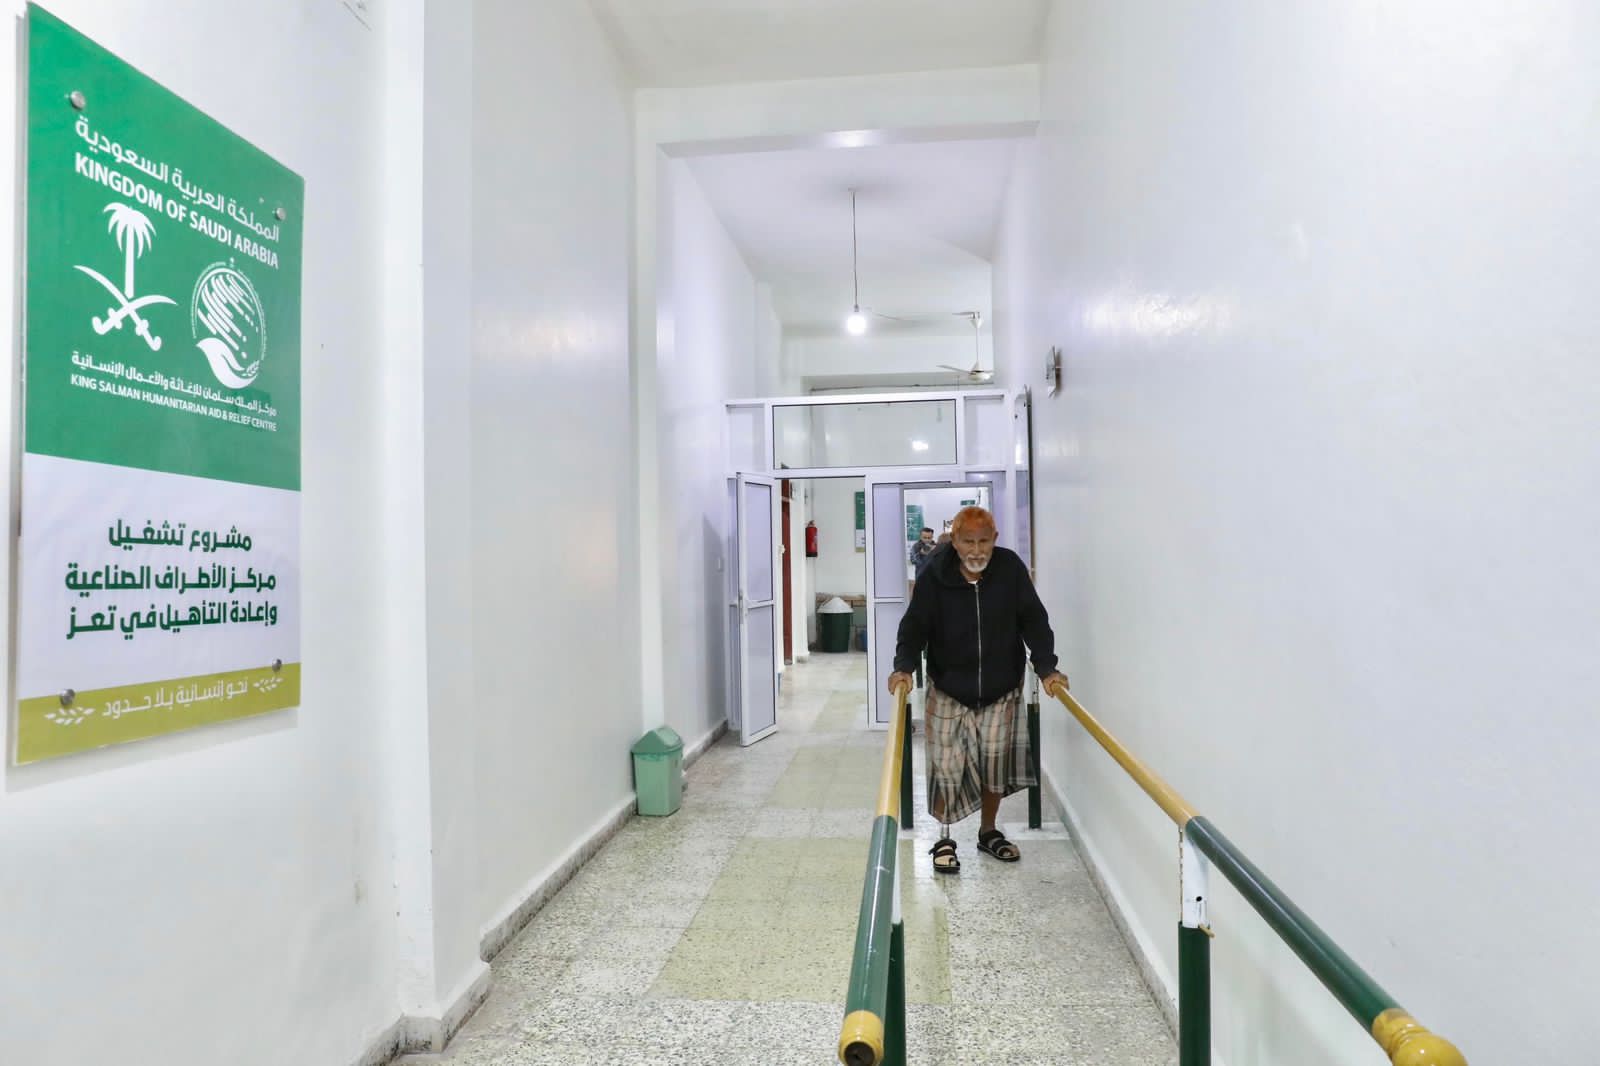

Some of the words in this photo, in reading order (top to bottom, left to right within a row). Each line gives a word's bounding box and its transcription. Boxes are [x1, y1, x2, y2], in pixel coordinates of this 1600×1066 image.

[75, 116, 168, 183] السعودية
[172, 168, 224, 210] العربية
[75, 152, 163, 212] KINGDOM
[166, 199, 187, 223] OF
[190, 211, 232, 246] SAUDI
[234, 232, 279, 269] ARABIA
[227, 198, 280, 243] المملكة
[71, 374, 97, 390] KING
[98, 380, 141, 400] SALMAN
[142, 391, 208, 416] HUMANITARIAN
[208, 407, 222, 419] AID
[222, 411, 228, 421] &
[228, 412, 251, 425] RELIEF
[251, 418, 277, 432] CENTRE
[108, 518, 186, 551] تشغيل
[189, 525, 252, 552] مشروع
[65, 562, 151, 598] الصناعية
[155, 562, 226, 594] الأطراف
[229, 566, 276, 593] مركز
[66, 604, 116, 640] تعز
[120, 603, 157, 640] في
[159, 600, 227, 633] التأهيل
[230, 600, 277, 627] وإعادة
[153, 687, 174, 710] بلا
[175, 680, 224, 707] إنسانية
[226, 677, 248, 699] نحو
[102, 694, 151, 720] حدود
